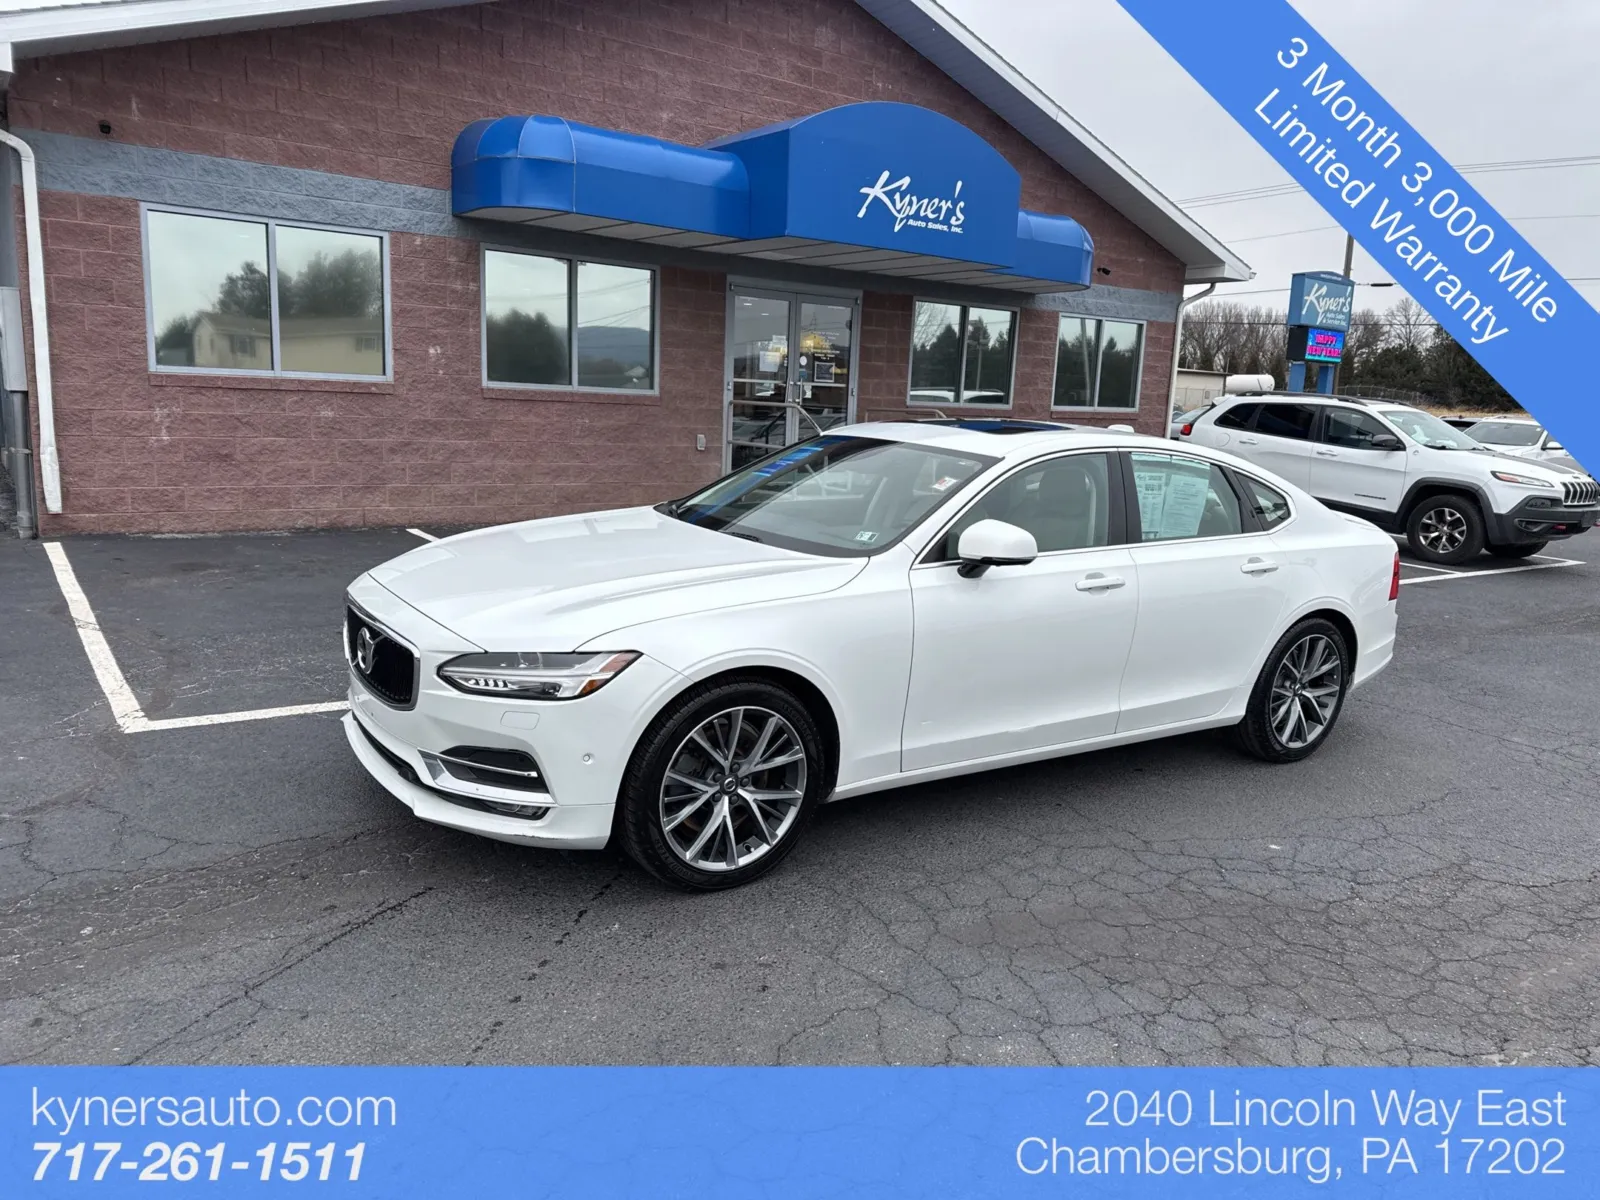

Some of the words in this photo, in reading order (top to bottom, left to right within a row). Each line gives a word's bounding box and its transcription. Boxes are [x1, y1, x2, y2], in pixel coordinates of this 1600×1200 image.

[856, 170, 965, 232] Kyner's
[907, 219, 926, 228] Auto
[951, 226, 964, 234] Inc.
[1302, 283, 1352, 325] Kyner's
[1316, 335, 1336, 344] HAPPY
[1307, 345, 1322, 355] NEW
